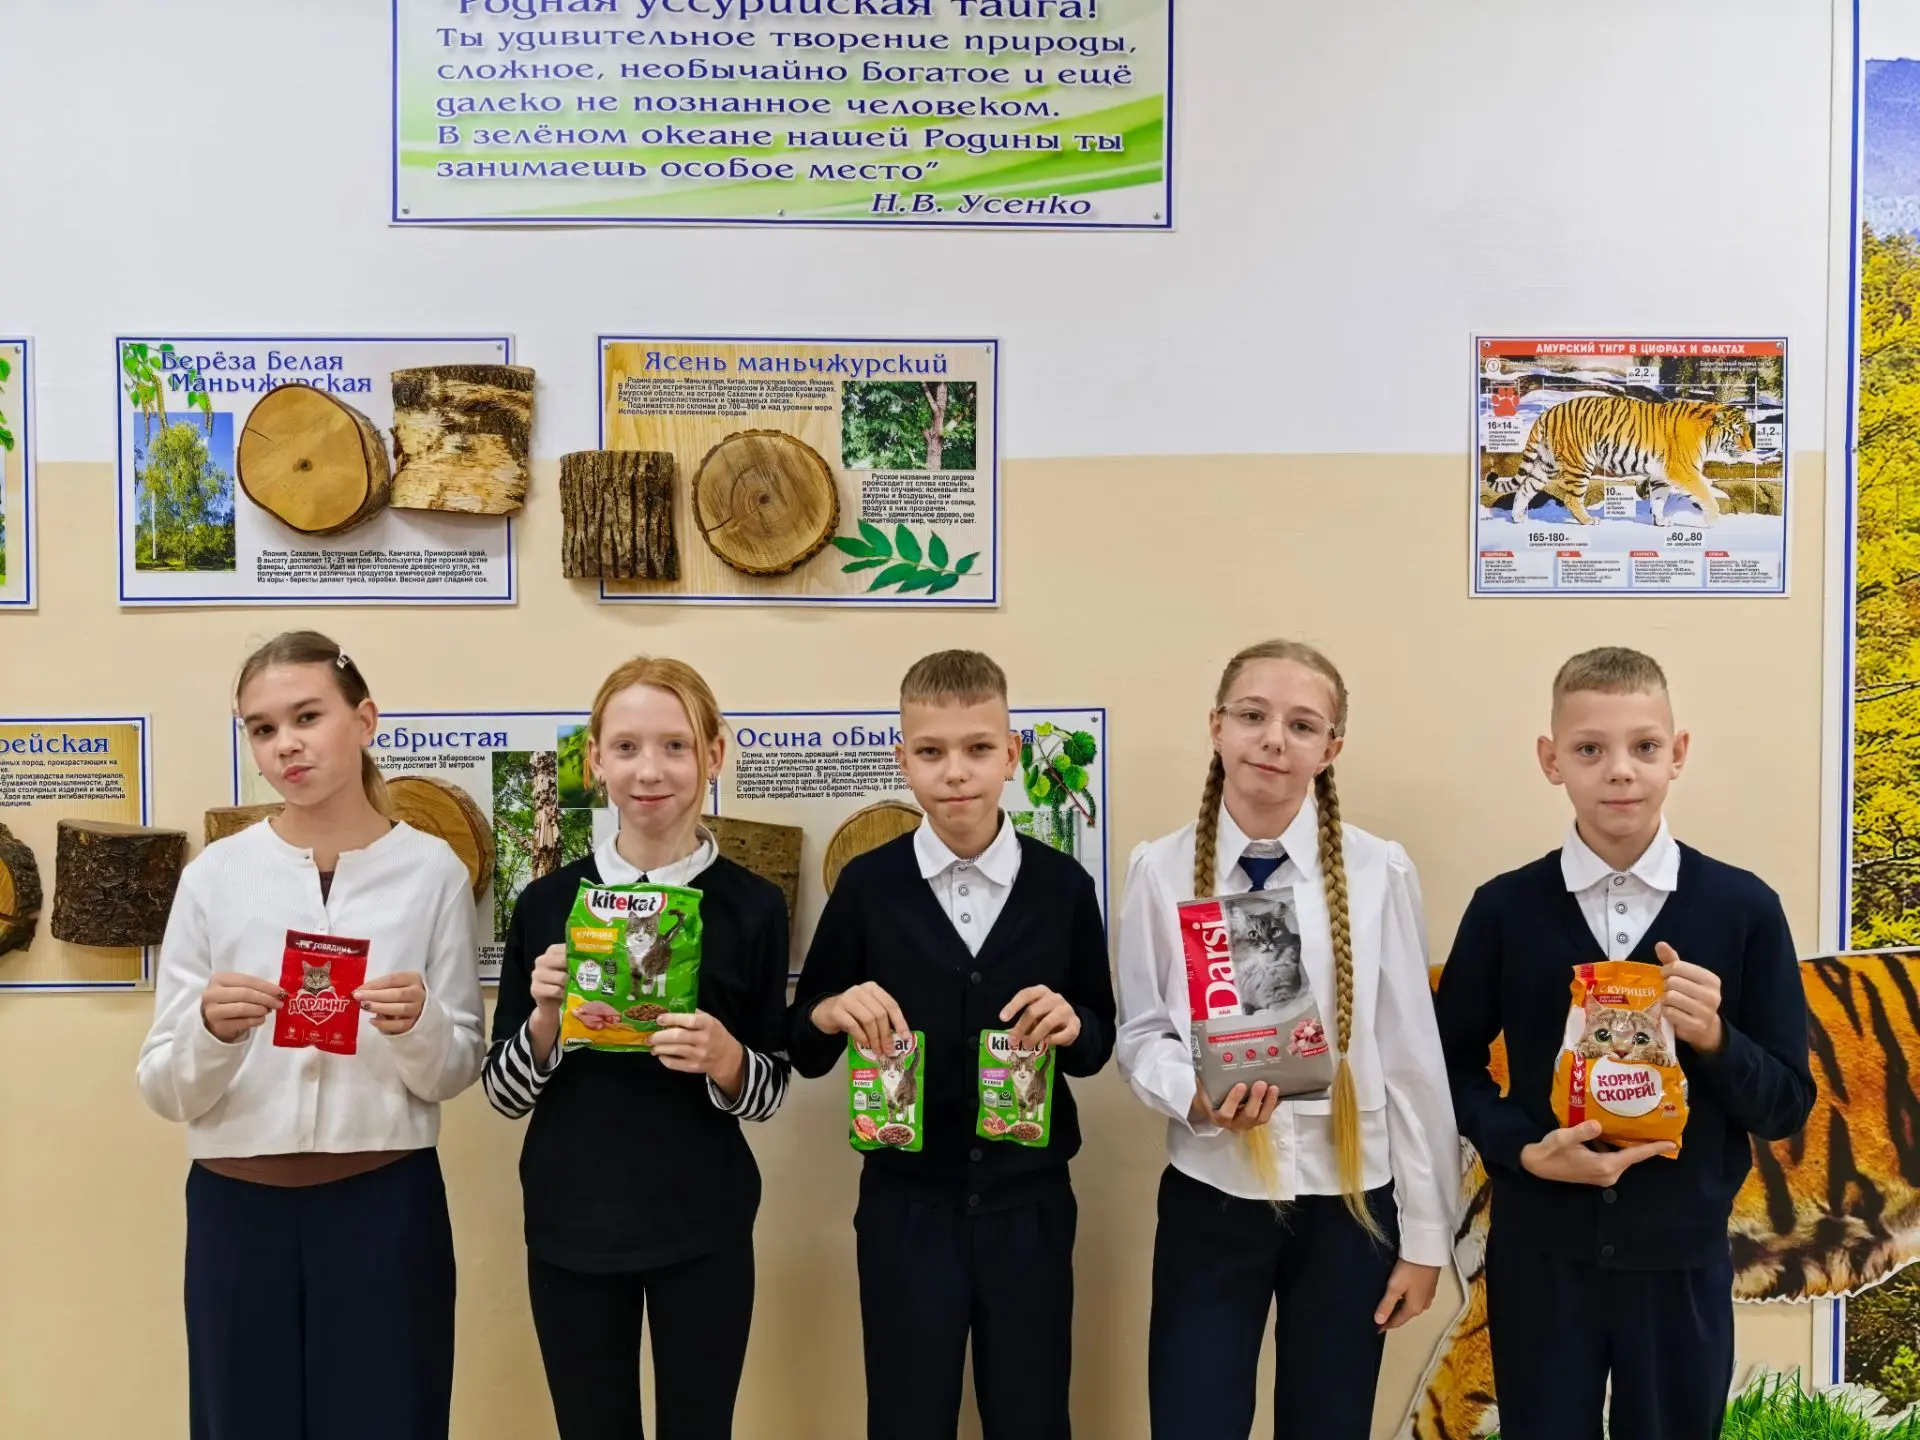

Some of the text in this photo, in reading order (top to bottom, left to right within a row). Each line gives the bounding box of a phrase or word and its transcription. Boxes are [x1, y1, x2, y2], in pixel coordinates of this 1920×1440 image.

[436, 28, 1137, 56] Ты удивительное творение природы,
[437, 58, 1132, 87] сложное, необычайно богатое и ещё
[436, 92, 1060, 117] далеко не познанное человеком.
[438, 124, 1124, 154] В зелёном океане нашей Родины ты
[436, 160, 647, 178] занимаешь
[660, 157, 794, 179] особое
[871, 193, 1092, 215] Н.В. Усенко
[1535, 341, 1745, 355] АМУРСКИЙ ТИГР В ЦИФРАХ И ФАКТАХ
[161, 351, 343, 375] Берёза белая
[644, 352, 947, 377] Ясень маньчжурский
[1529, 533, 1565, 542] 165-180
[370, 727, 508, 752] ебристая
[736, 727, 822, 747] Осина
[591, 890, 656, 912] kitekat
[1192, 919, 1243, 1015] Darsi
[1607, 984, 1656, 998] КУРИЦЕЙ
[288, 997, 350, 1015] ДАРЛИНГ
[1597, 1070, 1650, 1088] КОРМИ
[1596, 1082, 1656, 1102] СКОРЕЙ!
